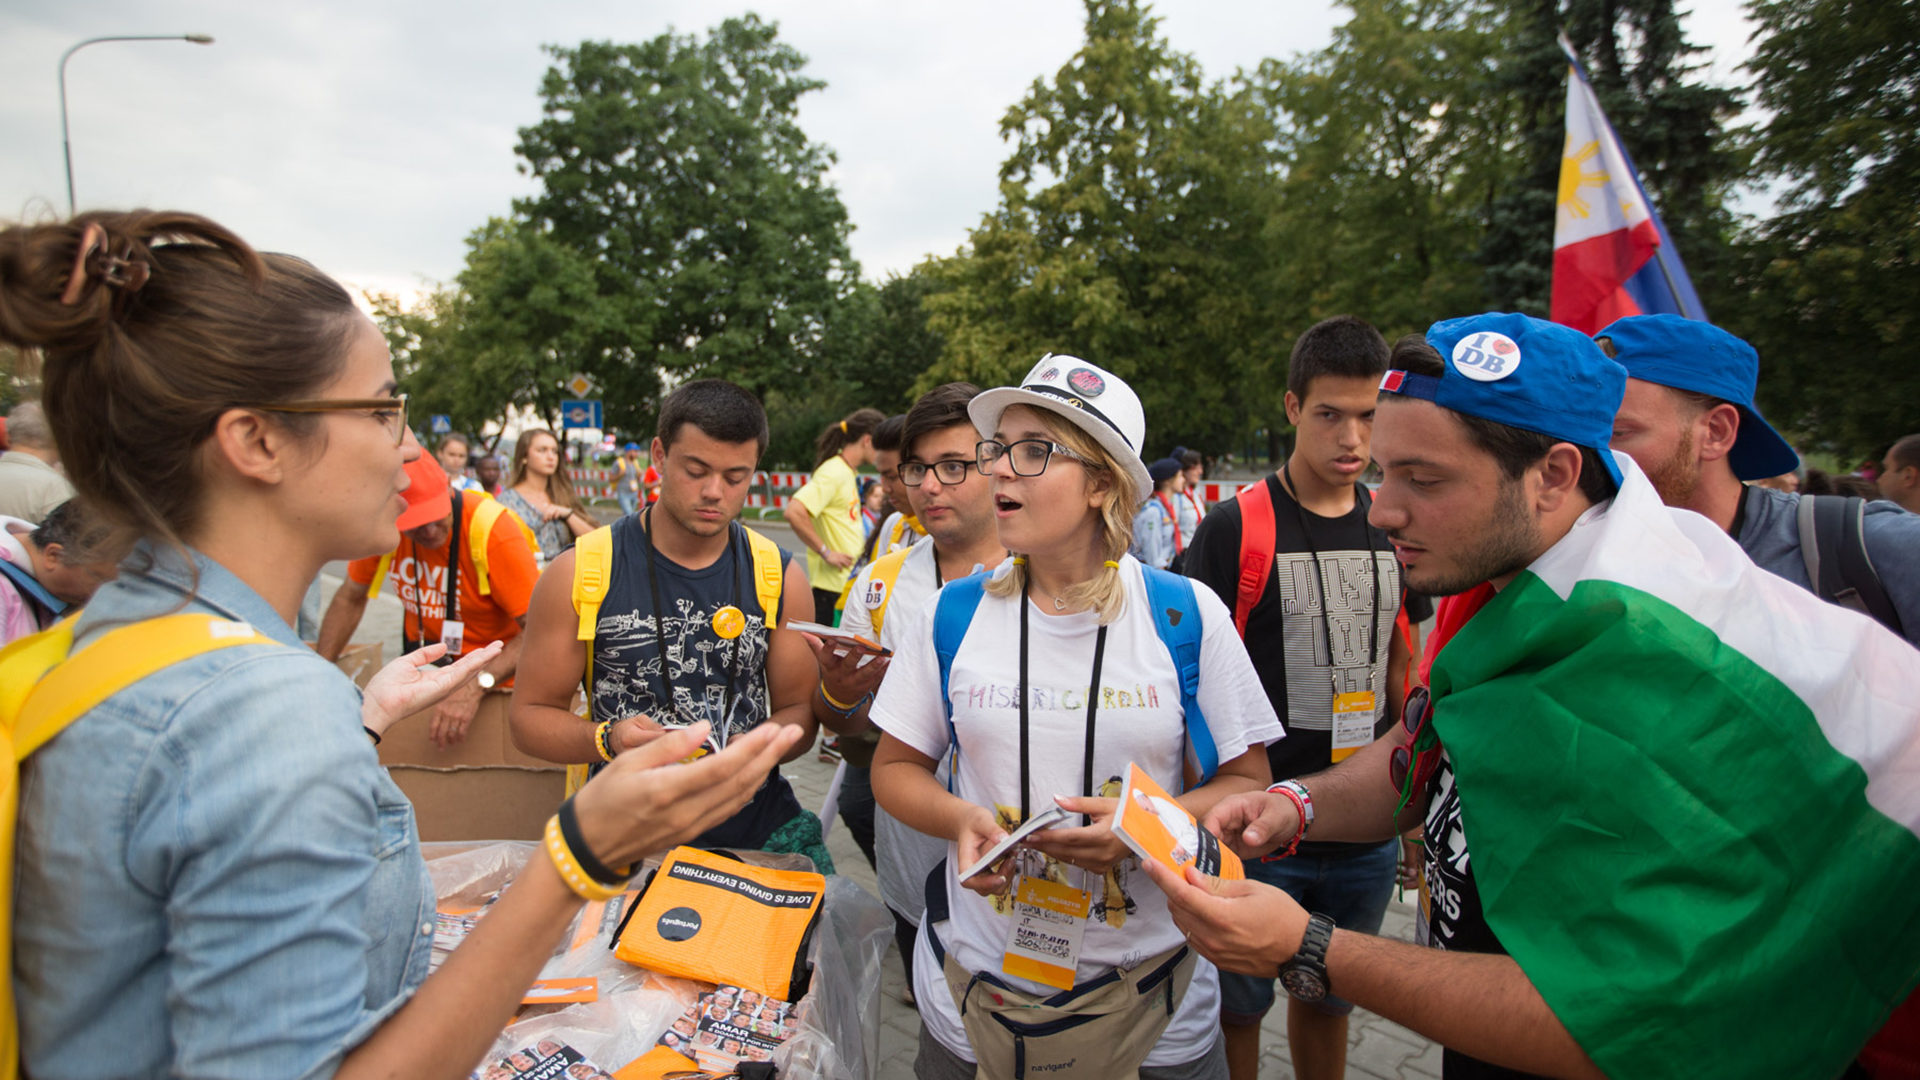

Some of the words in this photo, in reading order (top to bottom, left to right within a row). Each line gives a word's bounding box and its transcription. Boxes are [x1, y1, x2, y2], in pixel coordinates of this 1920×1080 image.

[1471, 334, 1489, 349] I
[1457, 346, 1506, 374] DB
[868, 582, 873, 592] I
[865, 592, 881, 603] DB
[673, 865, 737, 888] EVERYTHING
[739, 881, 773, 902] GIVING
[774, 893, 786, 903] IS
[786, 894, 812, 904] LOVE
[710, 1021, 749, 1038] AMAR
